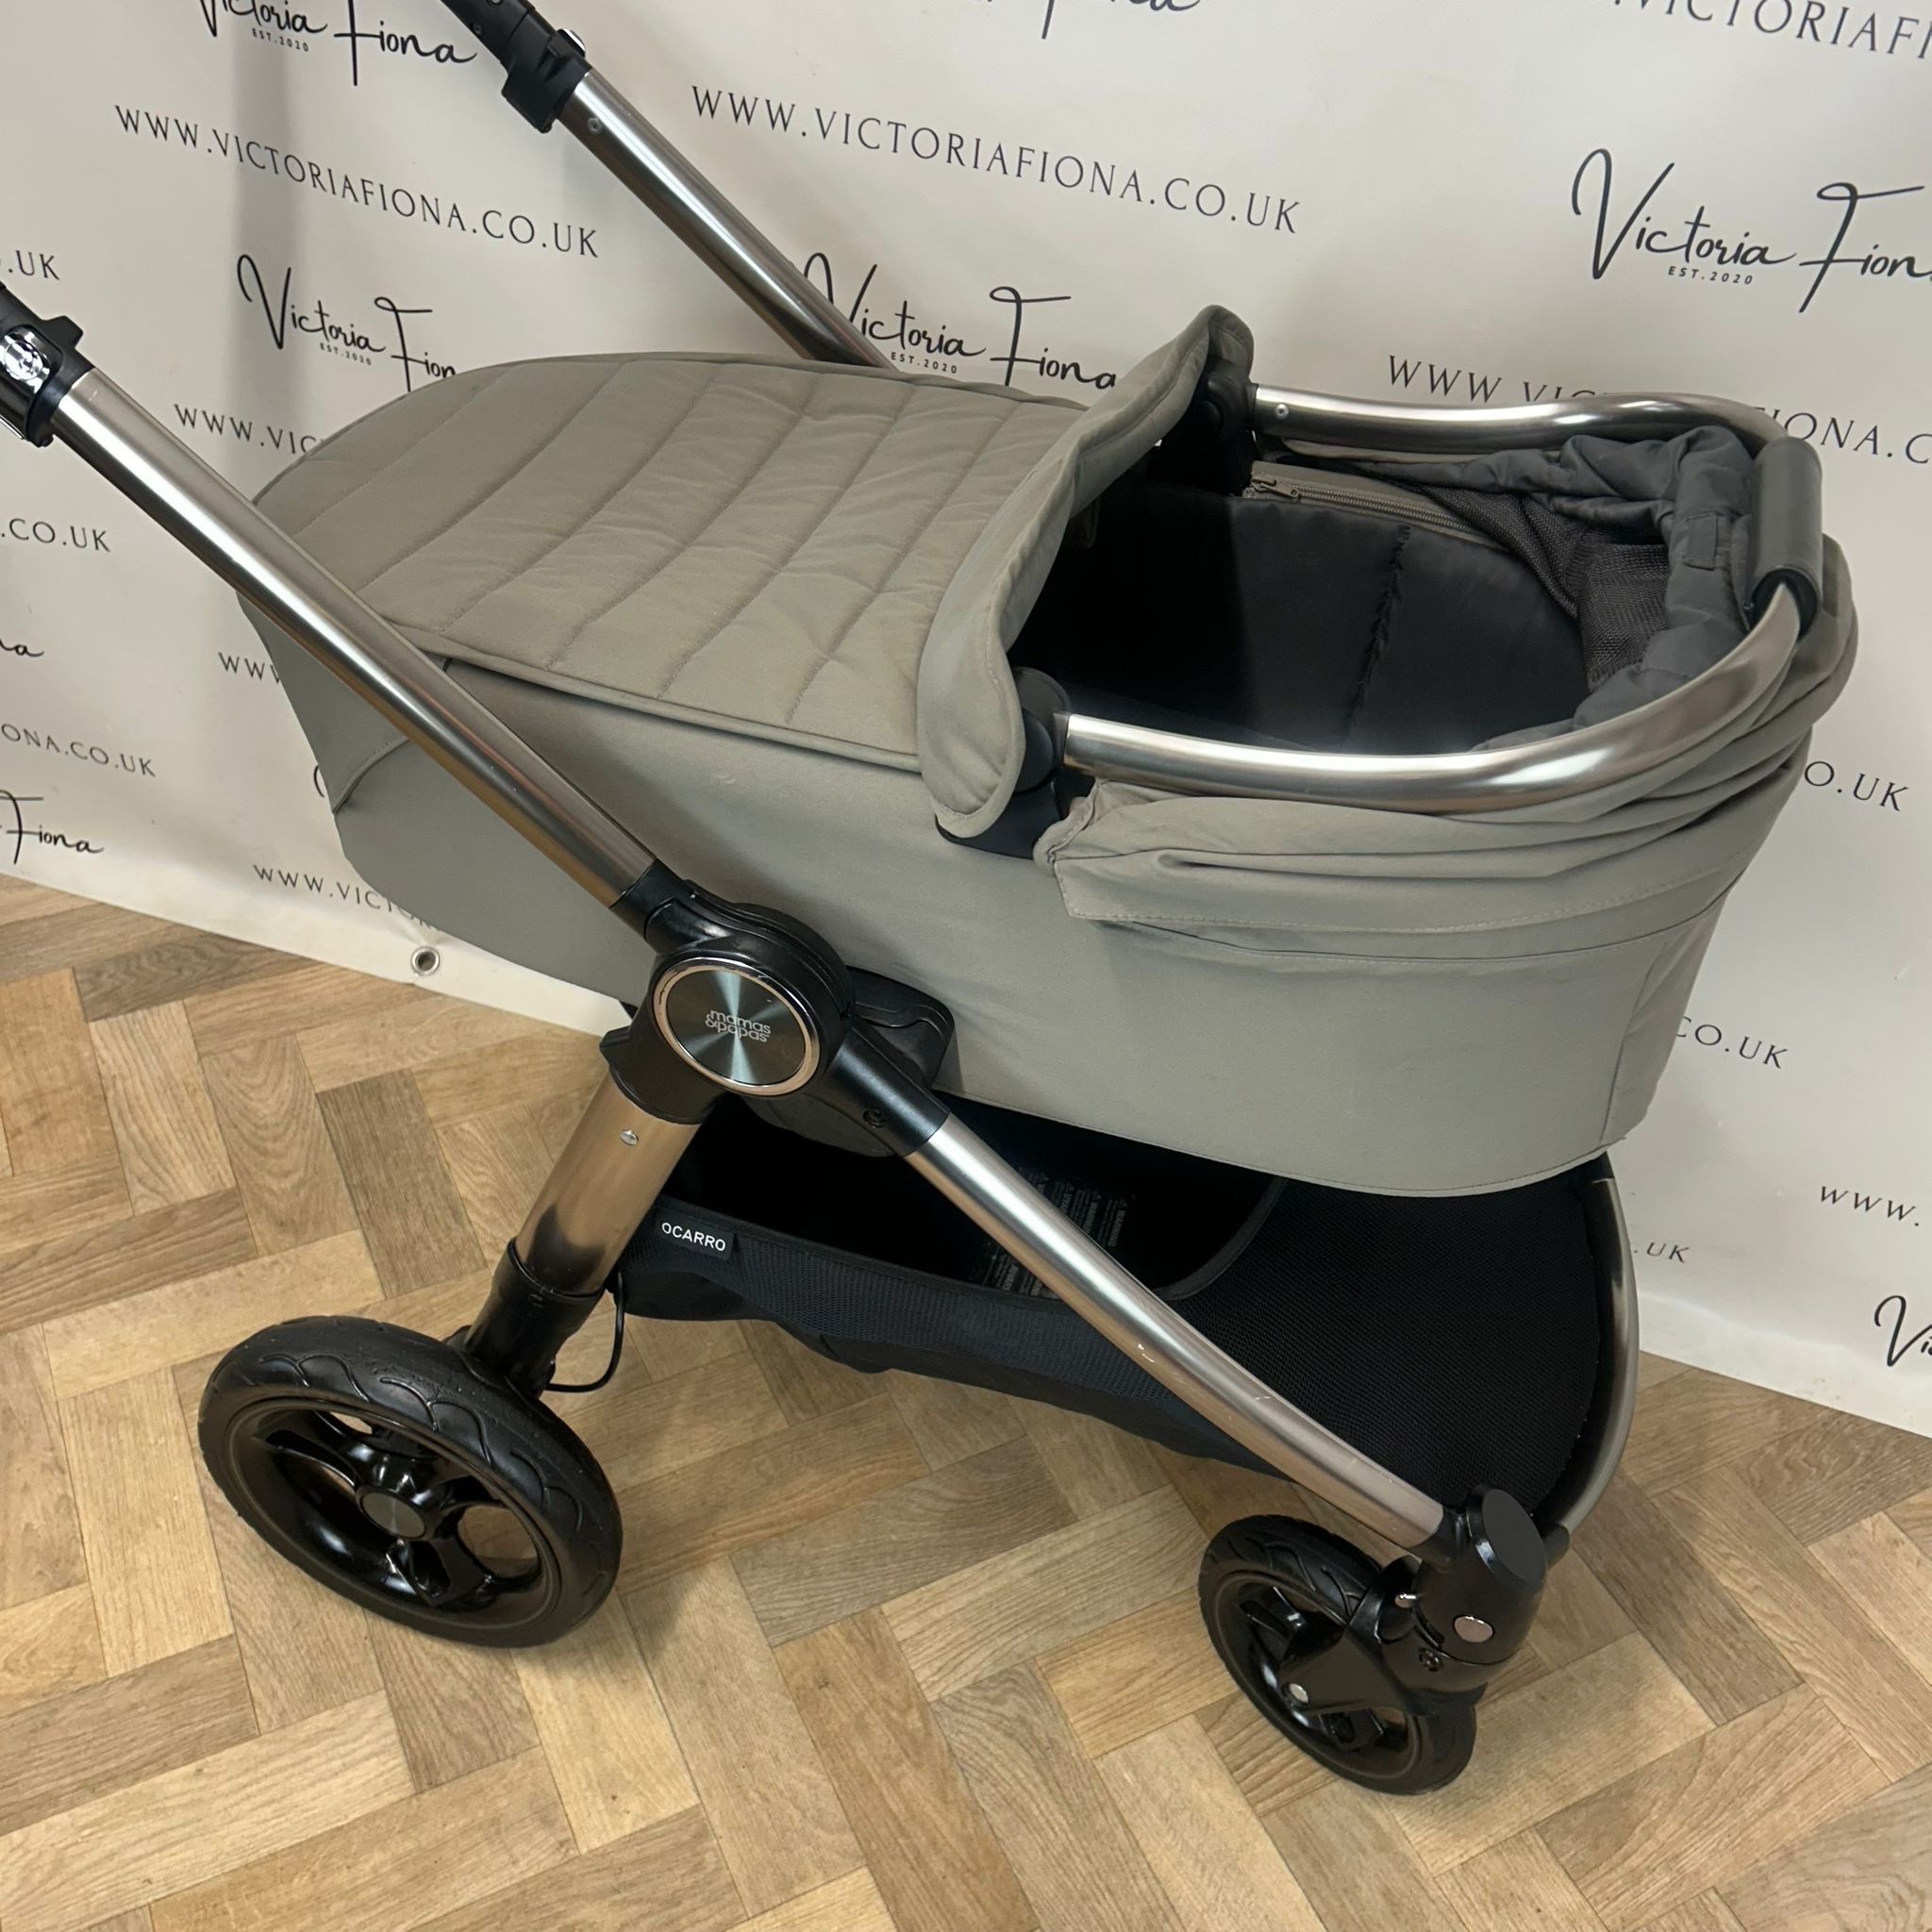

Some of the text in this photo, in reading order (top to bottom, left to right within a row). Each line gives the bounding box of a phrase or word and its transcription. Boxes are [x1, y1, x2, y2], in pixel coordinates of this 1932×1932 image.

[252, 27, 309, 52] EST.2020
[691, 85, 1301, 234] WWW.VICTORIAFIONA.CO.UK
[114, 105, 599, 258] WWW.VICTORIAFIONA.CO.UK
[1572, 148, 1798, 280] Victoria
[1667, 265, 1754, 285] EST.2020
[237, 254, 387, 351] Victoria
[319, 341, 373, 366] EST.2020
[989, 285, 1117, 388] Fiona
[891, 351, 958, 375] EST.2020
[0, 723, 157, 778] ONA.CO.UK
[709, 1009, 772, 1035] mamas
[661, 1222, 726, 1252] OCARRO
